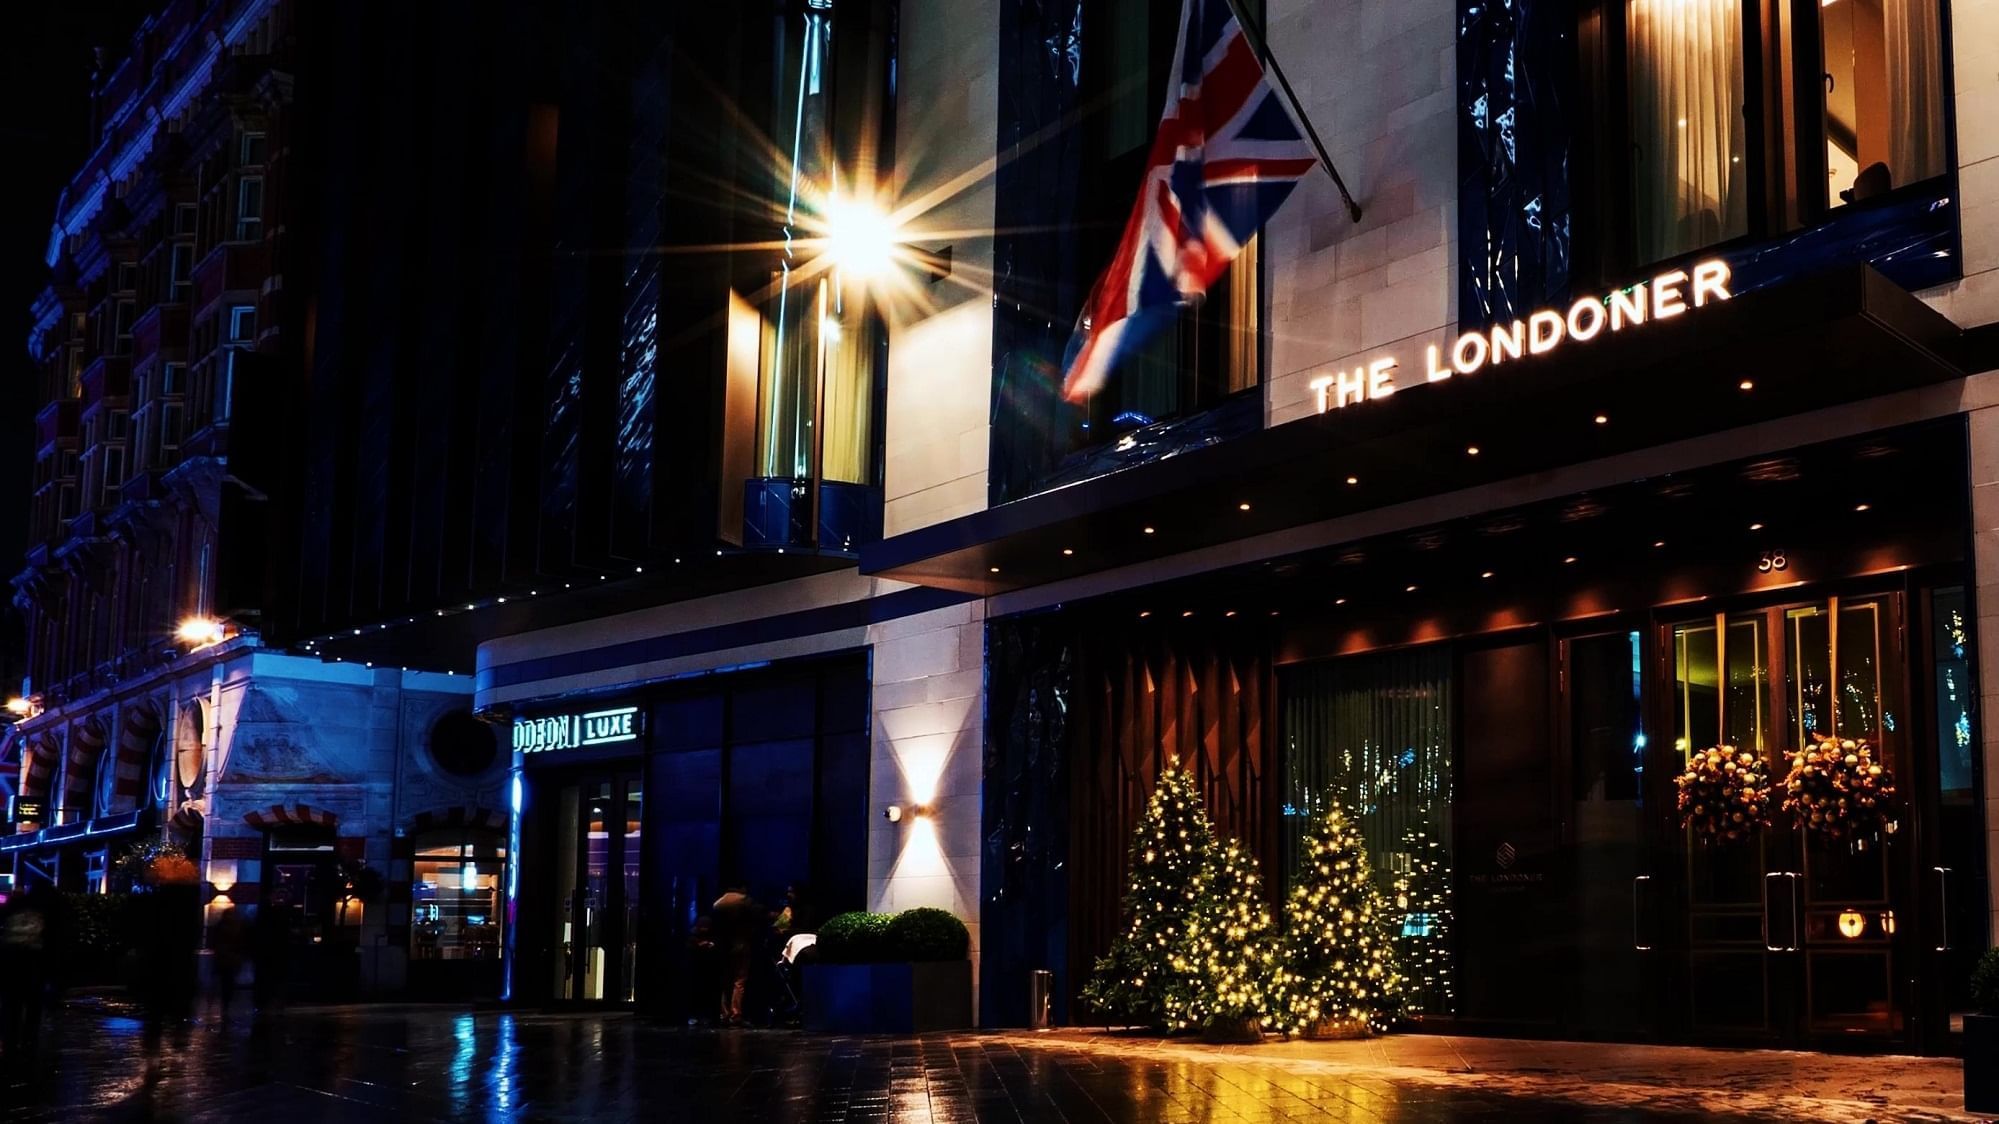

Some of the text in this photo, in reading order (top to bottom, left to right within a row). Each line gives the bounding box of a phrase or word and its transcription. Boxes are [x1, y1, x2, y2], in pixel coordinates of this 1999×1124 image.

[1310, 260, 1732, 413] THE LONDONER
[1758, 550, 1786, 571] 38
[512, 713, 633, 753] ODEON LUXE
